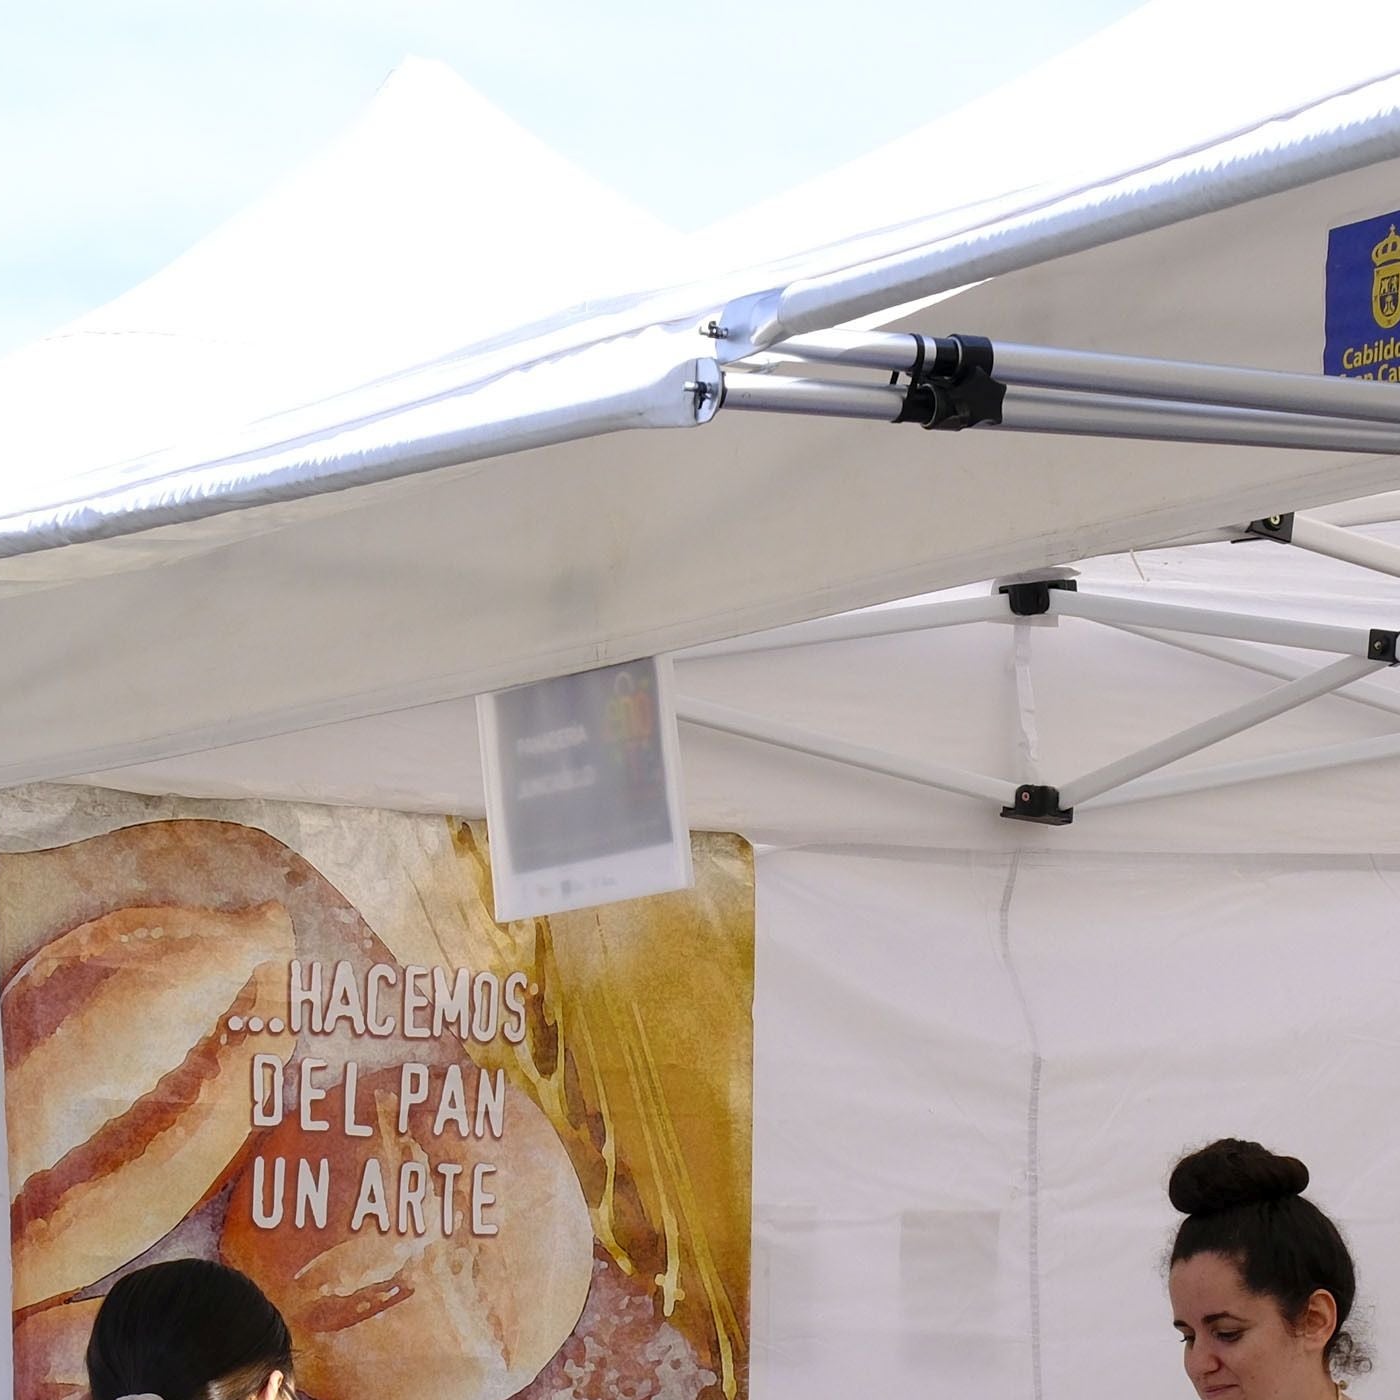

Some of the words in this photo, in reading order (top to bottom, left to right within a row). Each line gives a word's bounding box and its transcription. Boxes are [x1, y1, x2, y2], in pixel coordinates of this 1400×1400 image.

[252, 1053, 373, 1137] DEL
[398, 1062, 506, 1138] PAN
[252, 1155, 330, 1230] UN
[351, 1158, 499, 1236] ARTE
